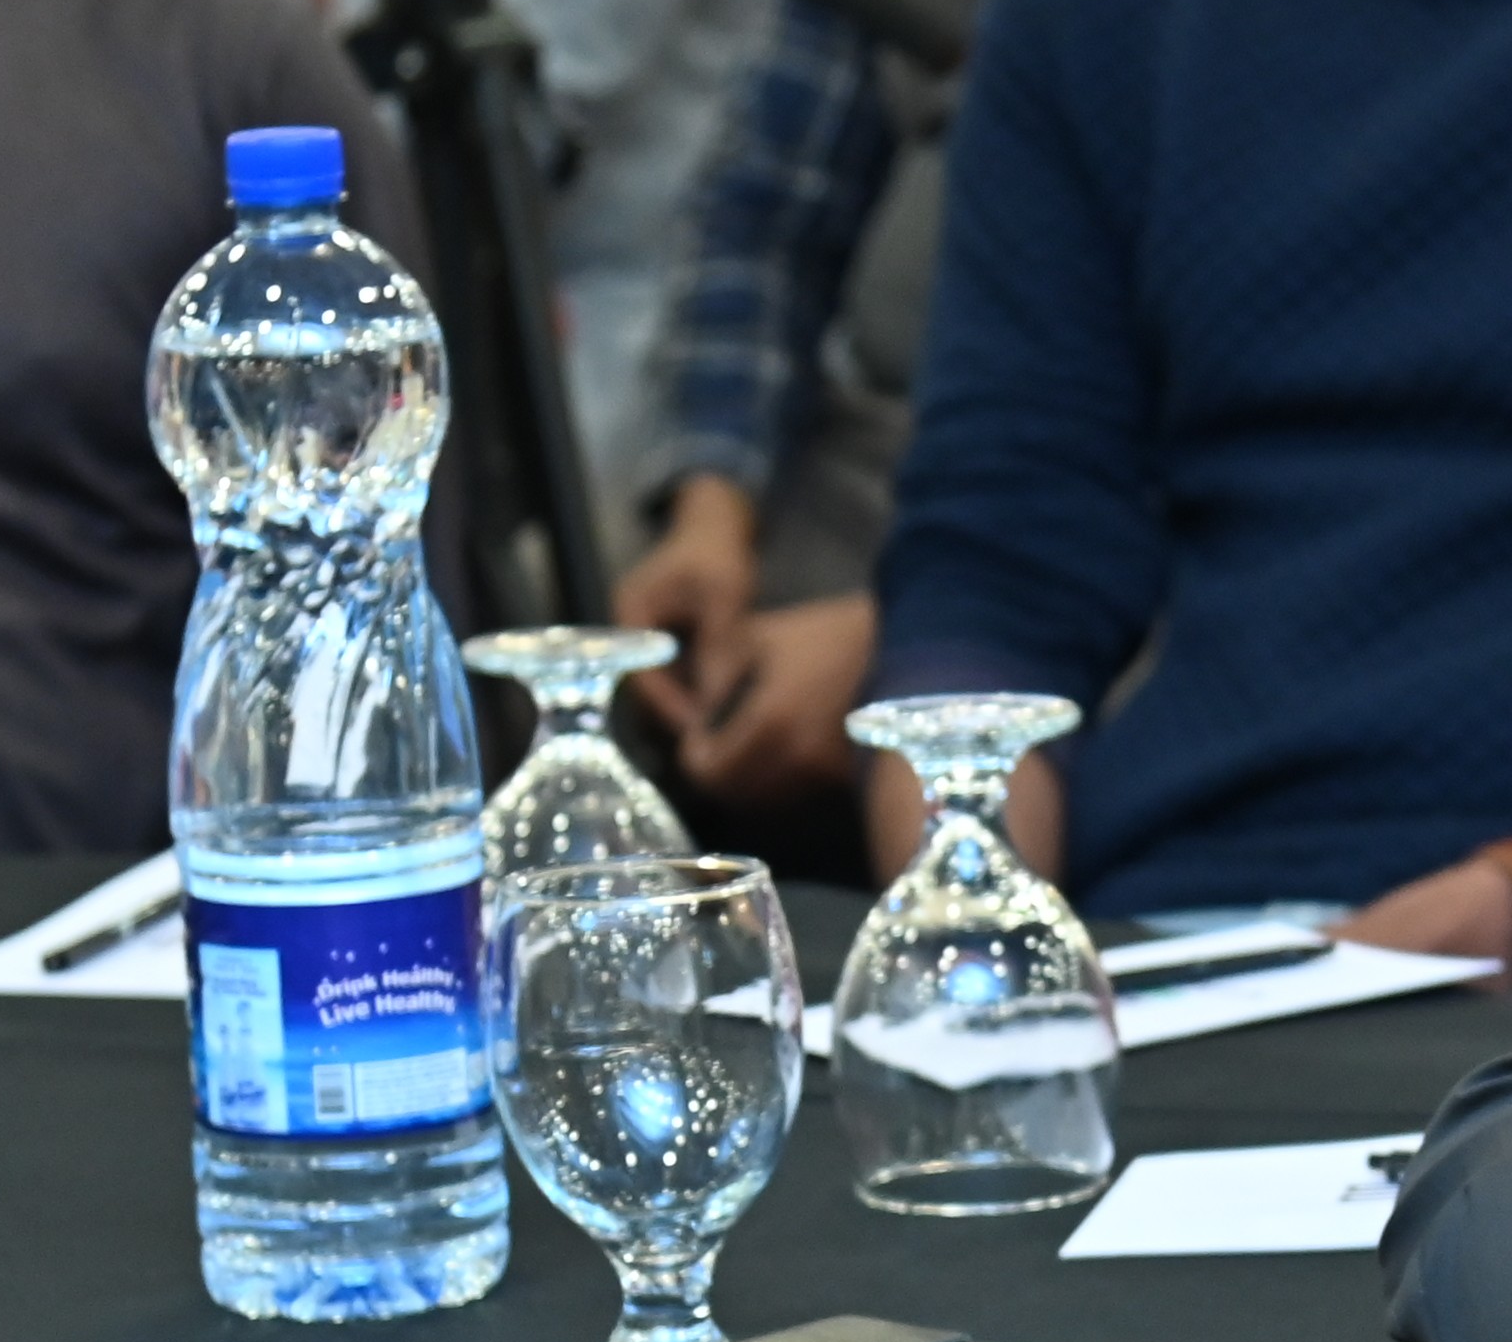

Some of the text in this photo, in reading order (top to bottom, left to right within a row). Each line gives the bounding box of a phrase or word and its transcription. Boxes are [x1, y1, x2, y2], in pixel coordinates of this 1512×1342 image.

[317, 966, 455, 1001] Drink Healthy
[320, 990, 456, 1028] Live Healthy
